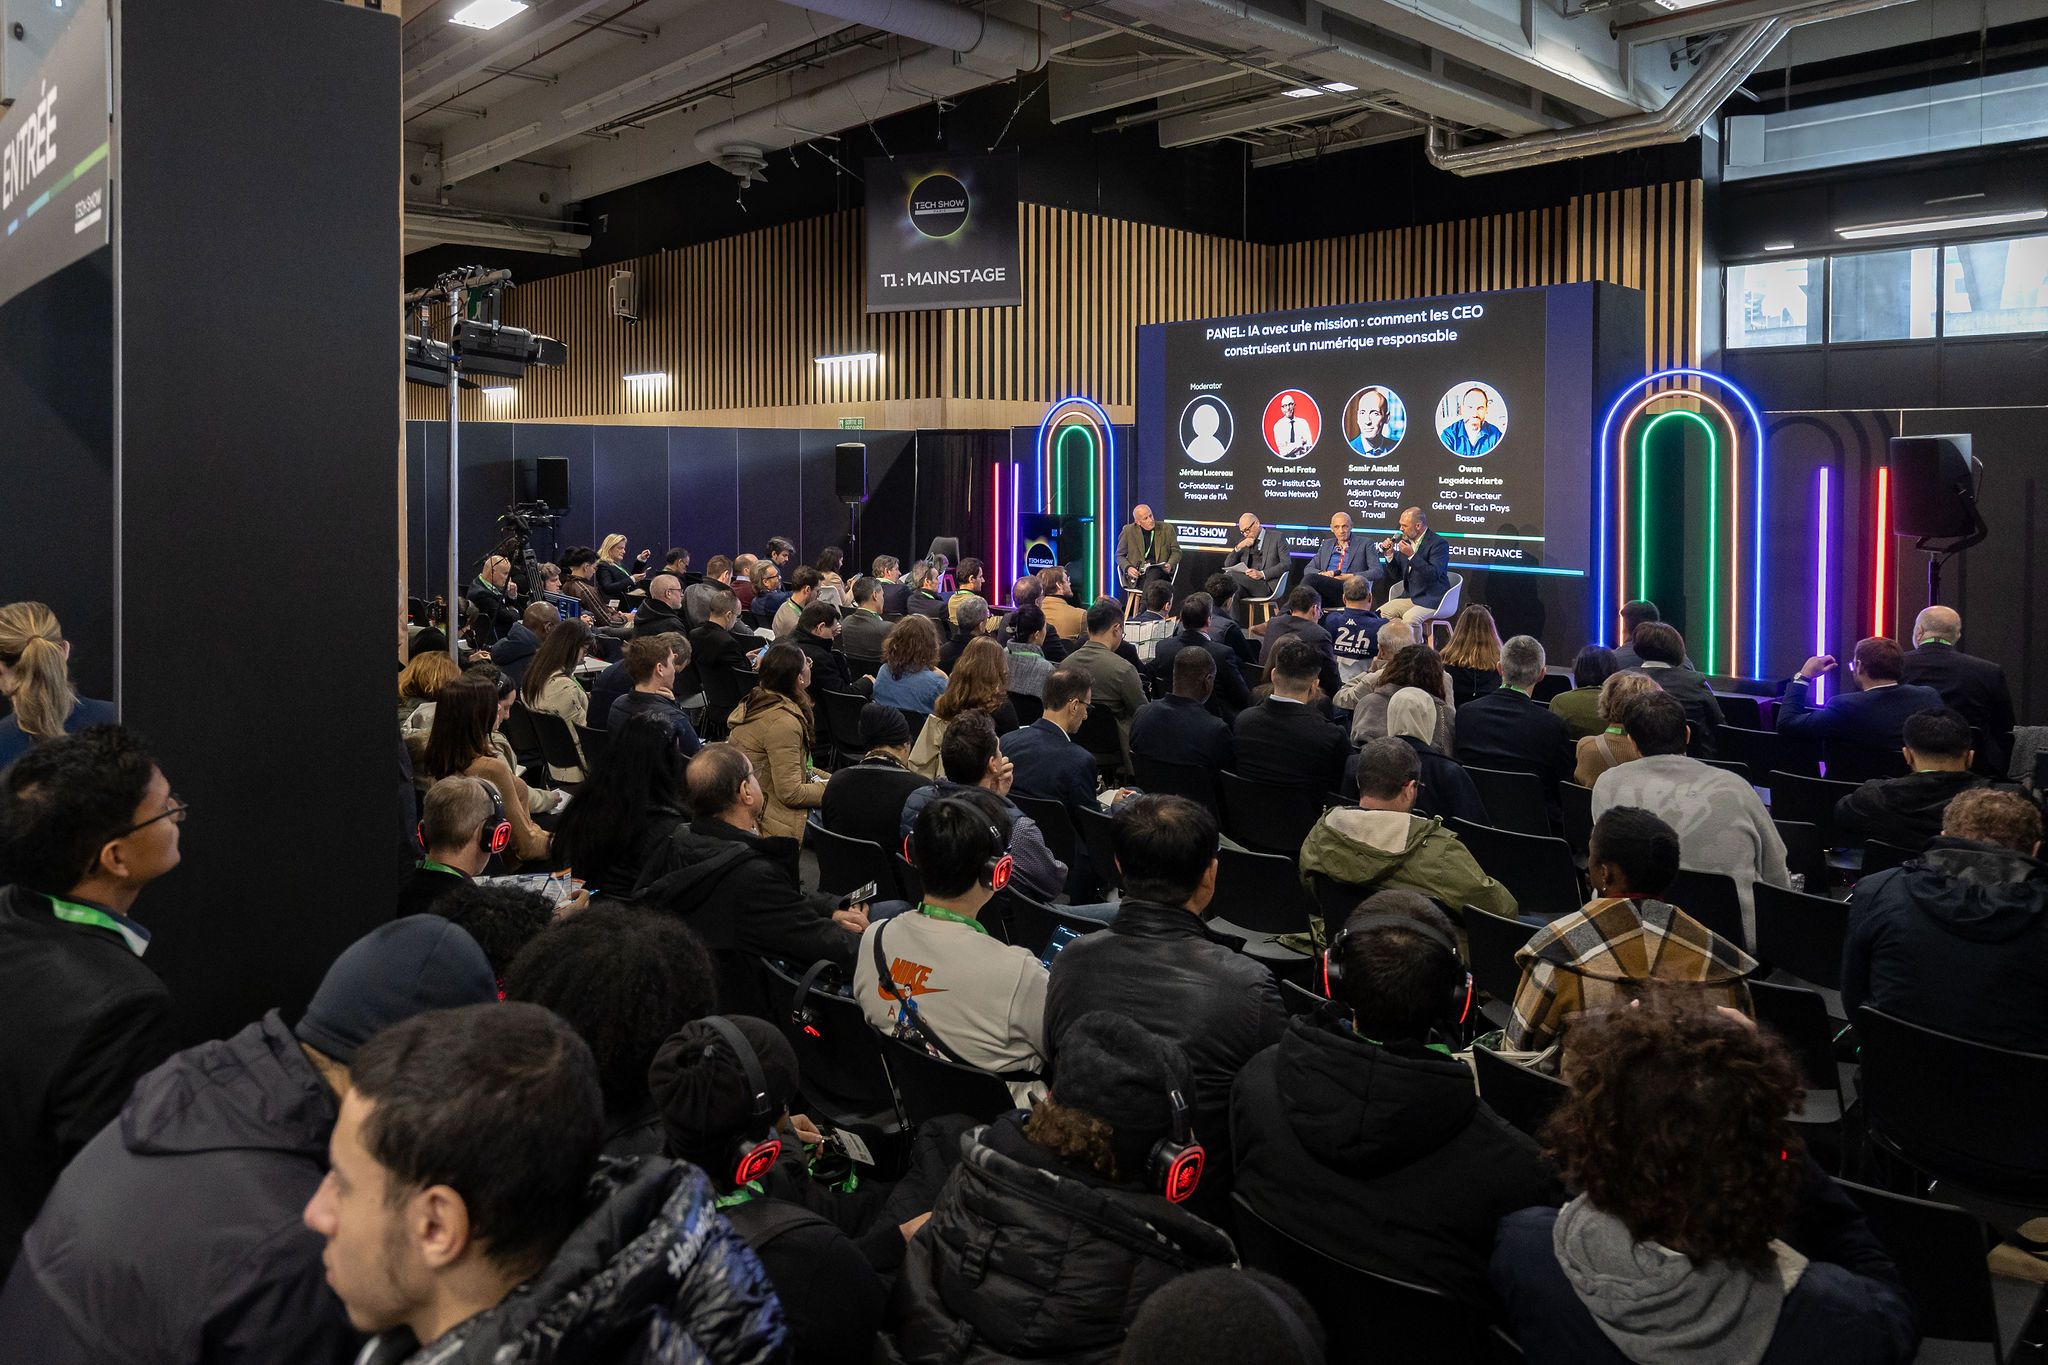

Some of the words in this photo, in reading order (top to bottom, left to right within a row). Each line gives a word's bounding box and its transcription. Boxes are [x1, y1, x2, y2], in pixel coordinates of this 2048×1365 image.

[3, 78, 57, 210] ENTRÉE
[915, 201, 937, 210] TECH
[938, 199, 965, 208] SHOW
[881, 273, 897, 287] T1
[907, 267, 1006, 286] MAINSTAGE
[1206, 326, 1246, 340] PANEL:
[1248, 325, 1260, 337] IA
[1262, 324, 1289, 335] avec
[1314, 317, 1358, 331] mission
[1367, 310, 1427, 326] comment
[1430, 309, 1449, 322] les
[1452, 305, 1484, 319] CEO
[1224, 341, 1291, 357] construisent
[1293, 340, 1307, 351] un
[1310, 336, 1374, 351] numérique
[1376, 329, 1458, 347] responsable
[1203, 469, 1234, 477] Lucereau
[1267, 466, 1283, 474] Yves
[1297, 466, 1316, 474] Frate
[1348, 464, 1370, 472] Samir
[1458, 465, 1483, 473] Owen
[1179, 482, 1220, 490] Co-Fondateur
[1262, 479, 1276, 487] CEO
[1282, 479, 1305, 487] Institut
[1306, 480, 1321, 488] CSA
[1343, 478, 1375, 486] Directeur
[1376, 478, 1405, 487] Général
[1438, 476, 1504, 486] Lagadec-Iriarte
[1184, 492, 1208, 501] Fresque
[1264, 489, 1288, 498] (Havas
[1288, 490, 1318, 499] Network)
[1346, 489, 1372, 498] Adjoint
[1372, 489, 1401, 499] (Deputy
[1440, 491, 1458, 499] CEO
[1464, 491, 1502, 500] Directeur
[1349, 500, 1368, 508] CEO)
[1373, 500, 1399, 509] France
[1432, 502, 1462, 511] Général
[1469, 503, 1489, 512] Tech
[1490, 504, 1511, 514] Pays
[1361, 511, 1386, 519] Travail
[1455, 514, 1485, 524] Basque
[1177, 526, 1199, 536] TECH
[1200, 527, 1227, 537] SHOW
[1296, 536, 1320, 547] DÉDIÉ
[1448, 546, 1466, 555] ECH
[1468, 547, 1481, 556] EN
[1482, 548, 1523, 559] FRANCE
[889, 957, 933, 986] NIKE
